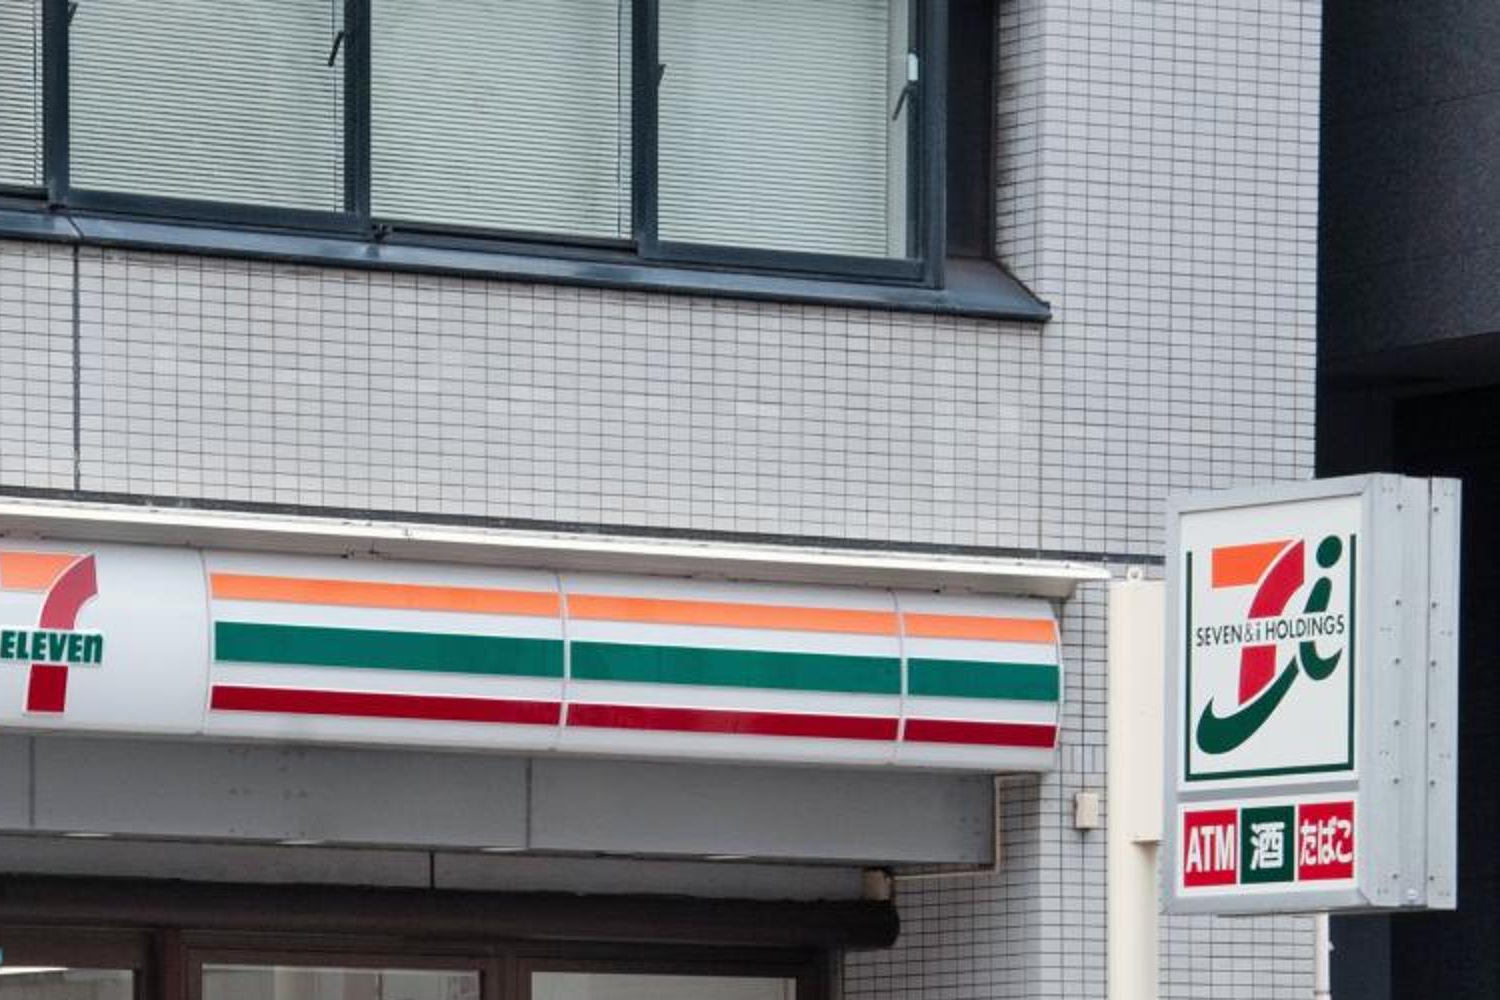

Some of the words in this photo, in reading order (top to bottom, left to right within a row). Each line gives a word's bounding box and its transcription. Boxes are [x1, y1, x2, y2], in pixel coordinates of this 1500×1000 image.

[1264, 613, 1346, 644] HOLDINGS
[1186, 824, 1235, 872] ATM
[1250, 821, 1285, 870] 酒
[1299, 816, 1354, 866] たばこ
